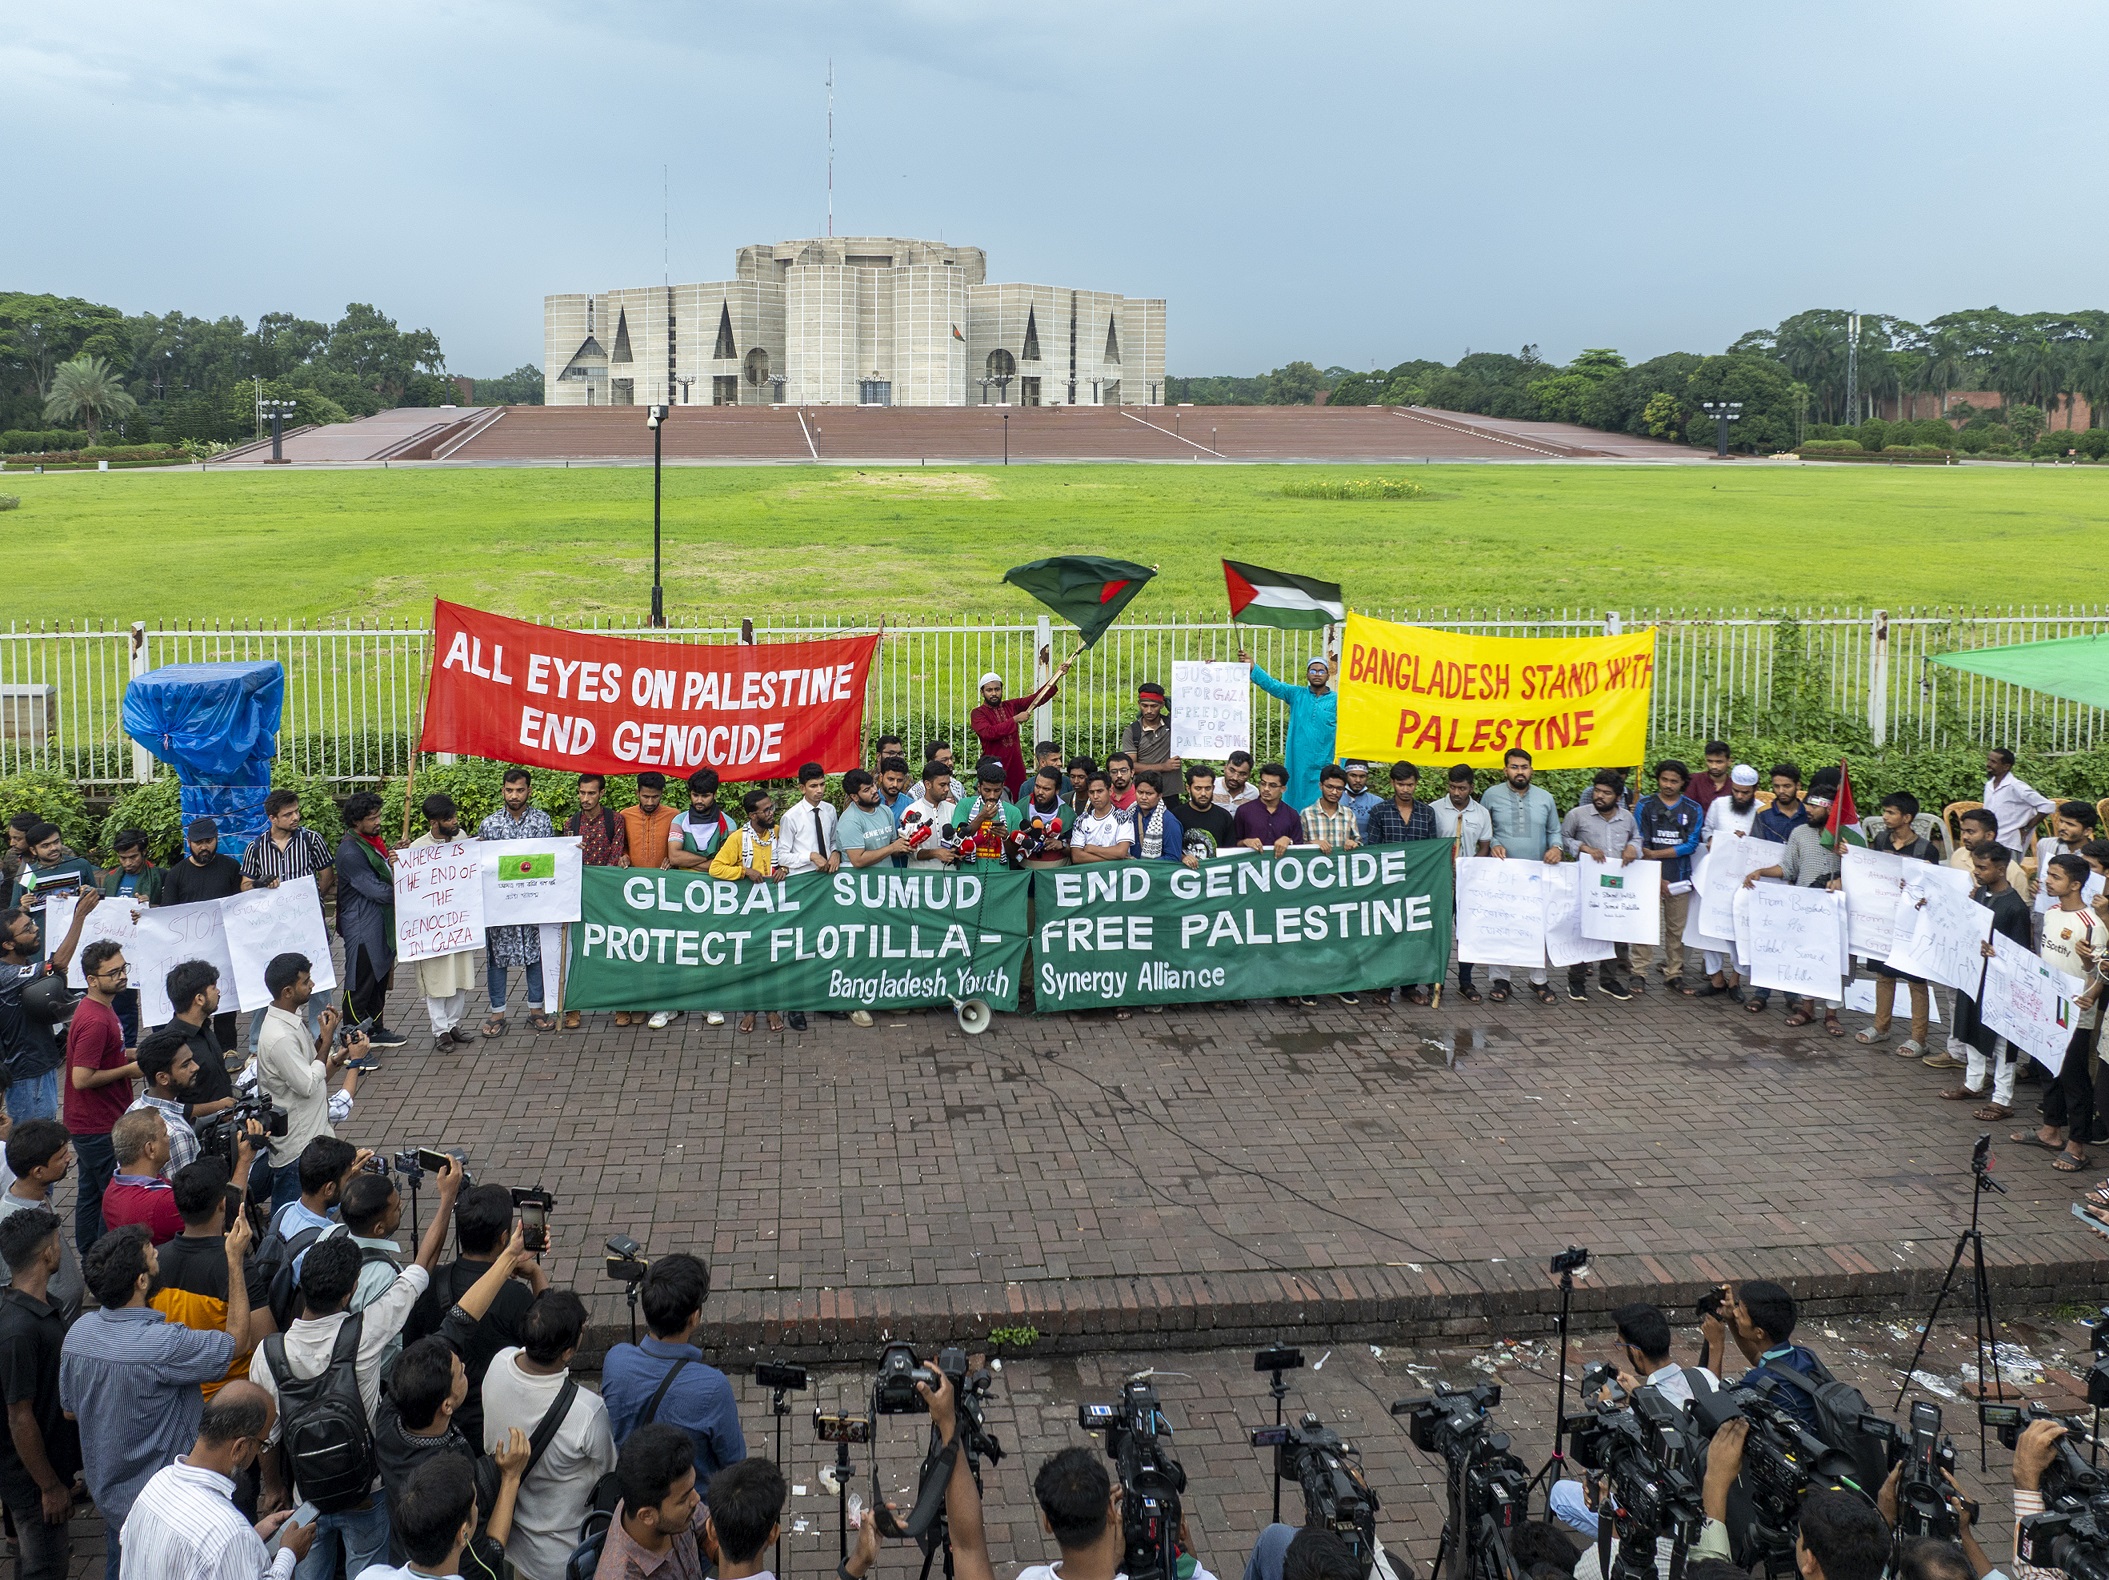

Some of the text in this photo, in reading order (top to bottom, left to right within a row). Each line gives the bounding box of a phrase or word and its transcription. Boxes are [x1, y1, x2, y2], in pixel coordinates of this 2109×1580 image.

[442, 632, 854, 710] ALL EYES ON PALESTINE
[1175, 666, 1249, 683] JUSTICE
[1349, 644, 1653, 700] BANGLADESH STAND WITH
[1174, 706, 1243, 721] FREEDOM
[1182, 686, 1246, 702] FOR GAZA
[519, 705, 785, 766] END GENOCIDE
[1198, 720, 1225, 731] FOR
[1396, 709, 1594, 753] PALESTINE
[397, 843, 465, 869] WHERE IS
[1852, 852, 1878, 866] Stop
[395, 863, 477, 894] THE END OF
[421, 888, 454, 907] THE
[623, 873, 982, 915] GLOBAL SUMUD
[1055, 850, 1407, 907] END GENOCIDE
[168, 907, 224, 946] STOP
[400, 910, 470, 941] GENOCIDE
[408, 926, 473, 957] IN GAZA
[1041, 915, 1153, 953] FREE
[1182, 894, 1433, 949] PALESTINE
[582, 923, 751, 966] PROTECT
[829, 966, 1009, 1005] Bangladesh Youth
[1041, 961, 1225, 1001] Synergy Alliance
